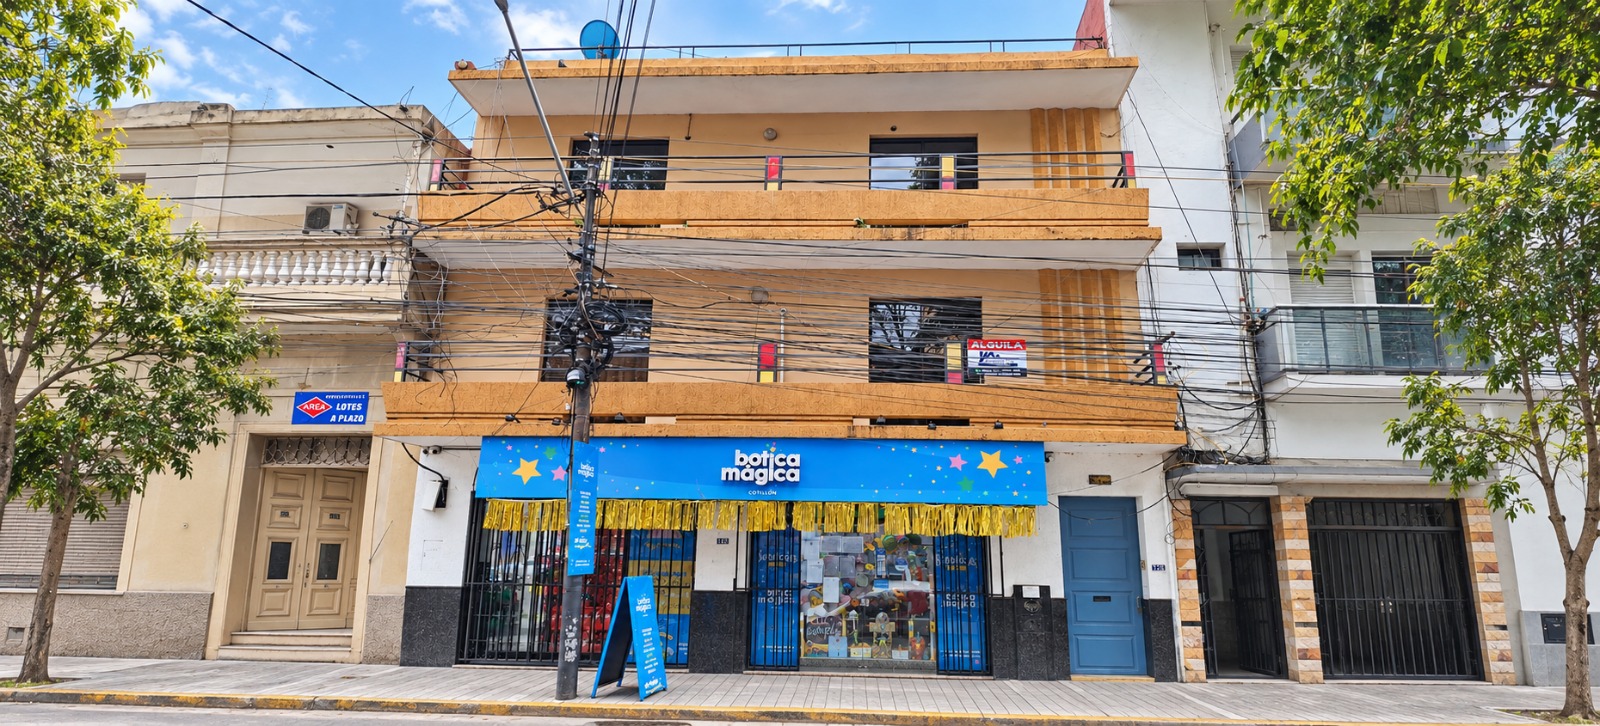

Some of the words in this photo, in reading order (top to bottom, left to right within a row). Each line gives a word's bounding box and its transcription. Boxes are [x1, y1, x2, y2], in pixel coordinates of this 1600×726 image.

[336, 403, 362, 411] LOTES
[330, 414, 336, 423] A
[338, 414, 364, 423] PLAZO
[735, 449, 801, 467] botica
[721, 465, 800, 486] mágica
